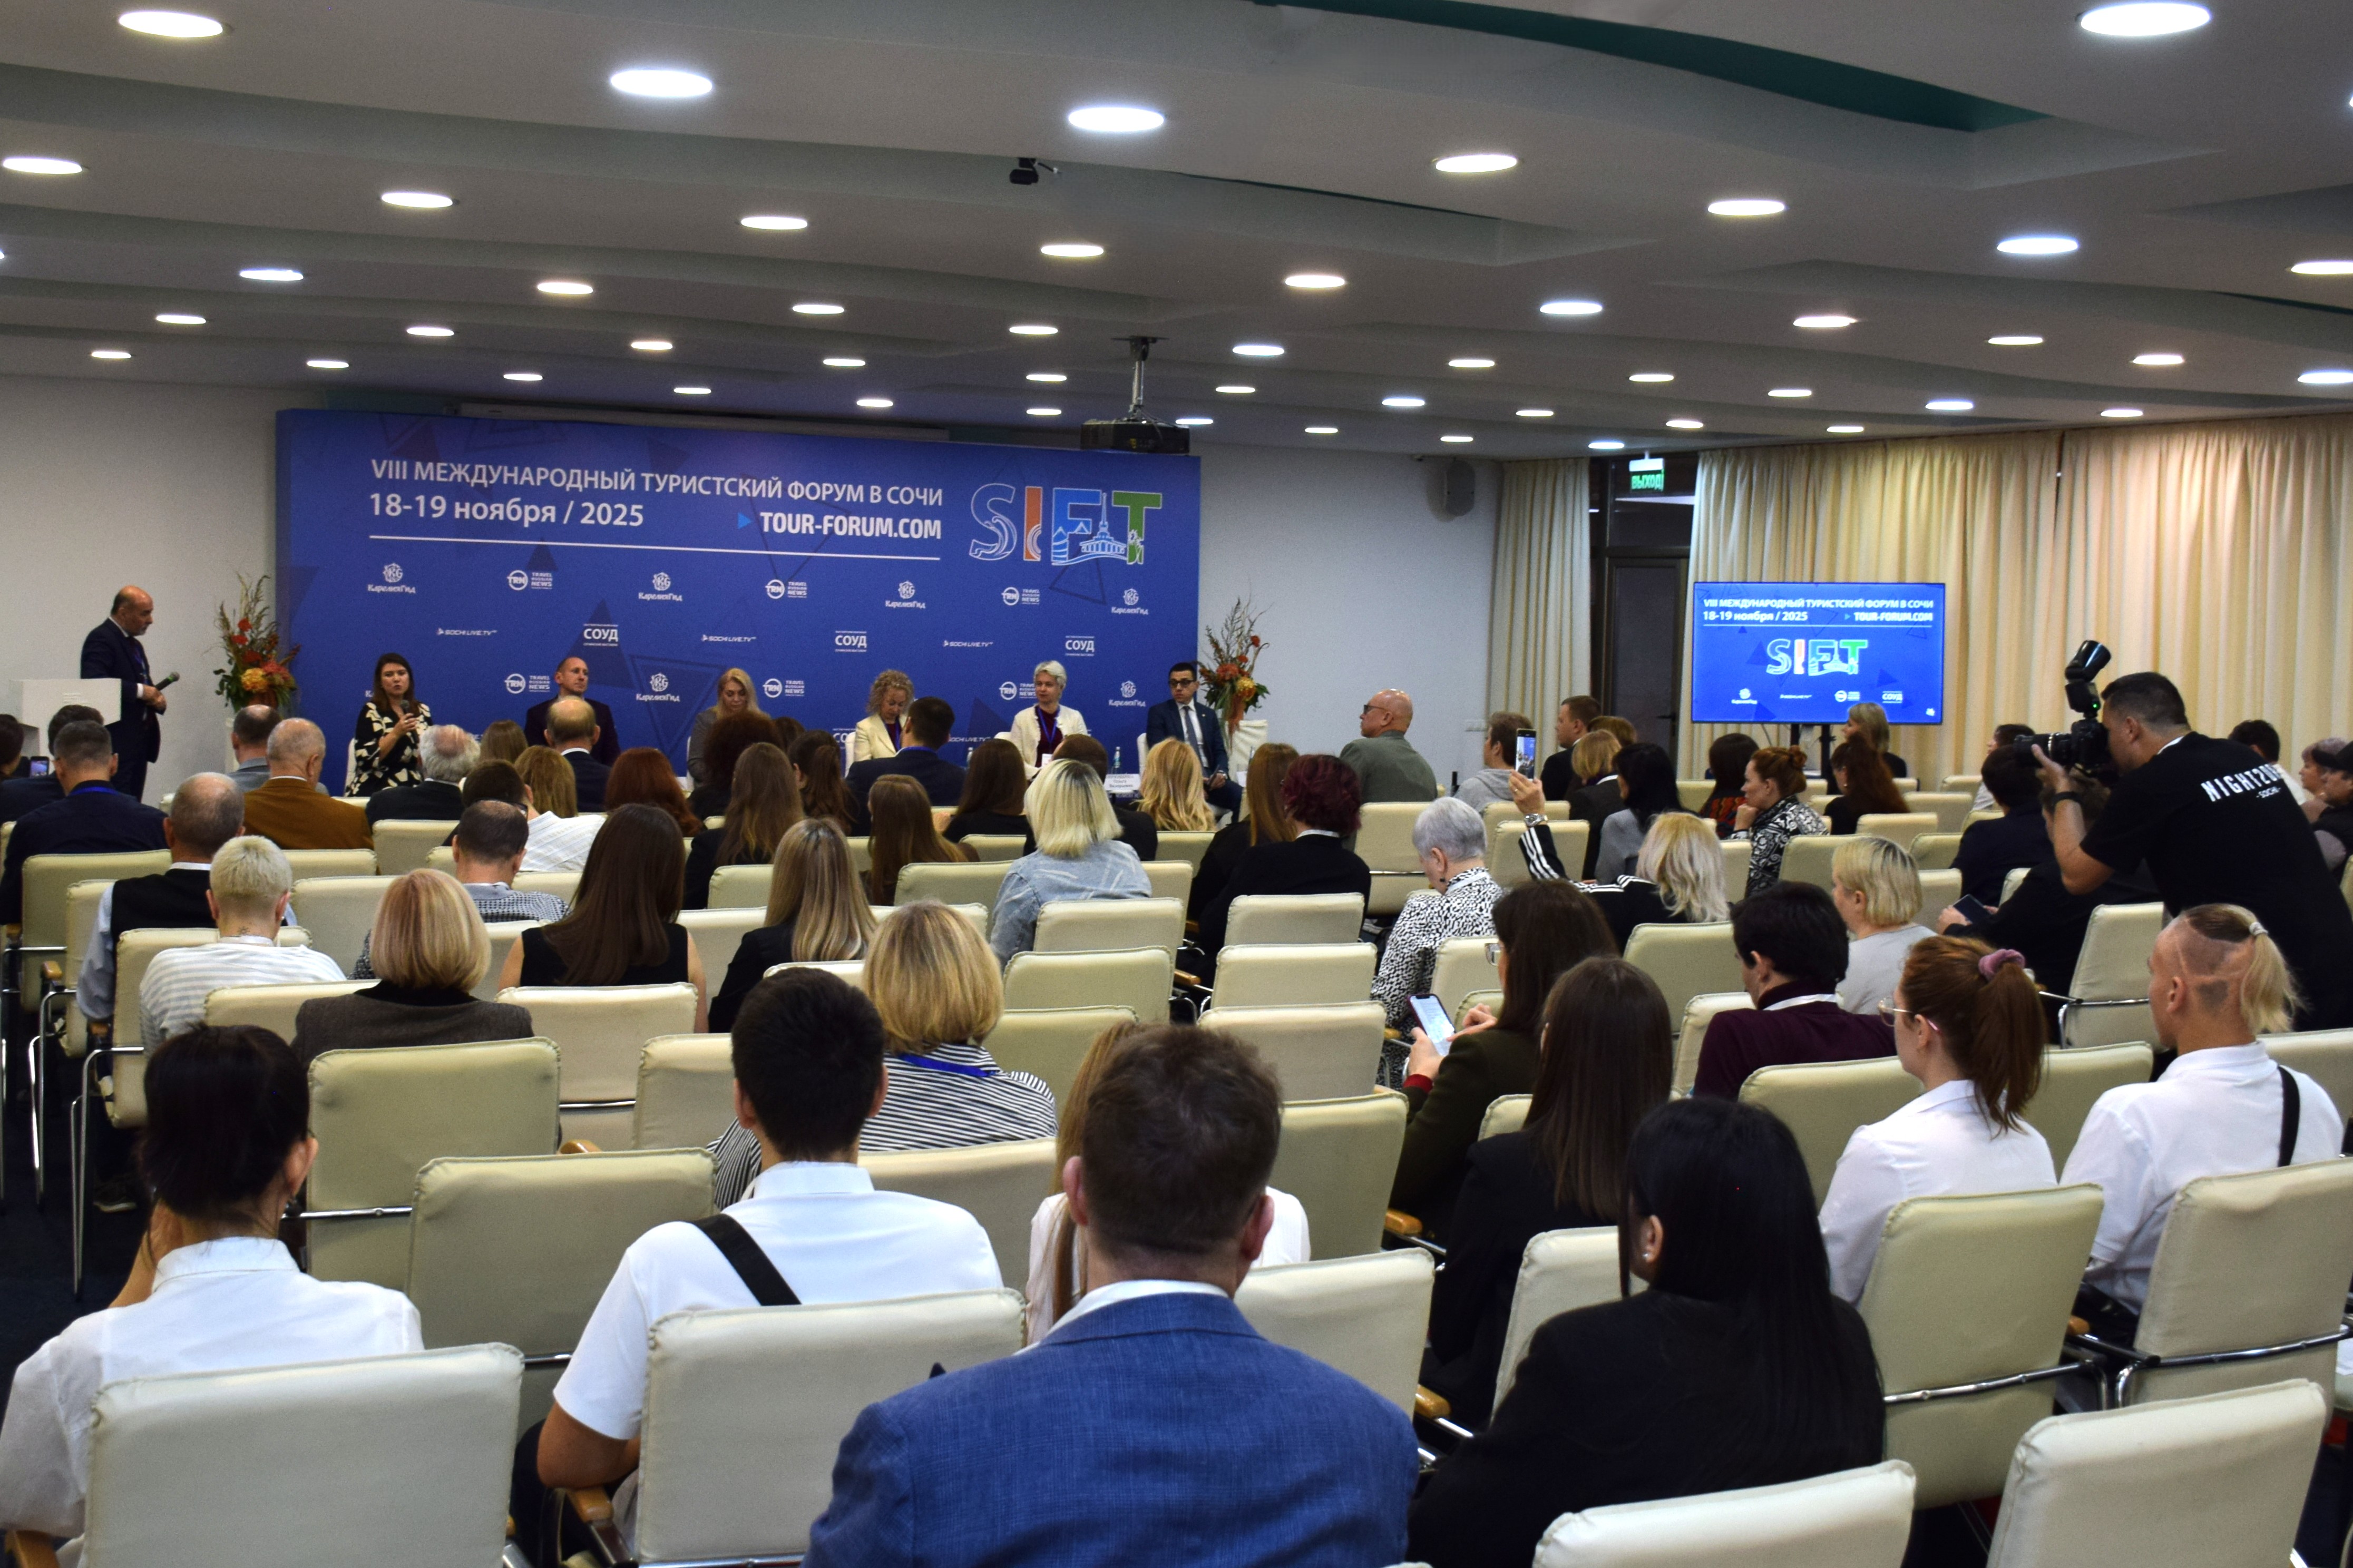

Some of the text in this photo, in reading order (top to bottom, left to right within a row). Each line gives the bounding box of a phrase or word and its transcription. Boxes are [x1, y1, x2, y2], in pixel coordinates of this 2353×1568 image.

[372, 459, 942, 506] VIII МЕЖДУНАРОДНЫЙ ТУРИСТСКИЙ ФОРУМ В СОЧИ
[1632, 474, 1663, 491] ВЫХОД
[370, 493, 643, 527] 18-19 ноября / 2025
[759, 512, 941, 540] TOUR-FORUM.COM
[969, 483, 1163, 565] SIFT
[1719, 599, 1805, 609] МЕЖДУНАРОДНЫЙ
[1806, 598, 1864, 608] ТУРИСТСКИЙ
[1865, 600, 1899, 608] ФОРУМ
[1908, 600, 1934, 608] СОЧИ
[1703, 610, 1808, 623] 18-19 ноября / 2025
[1853, 612, 1934, 621] TOUR-FORUM.COM
[583, 628, 619, 642] СОУД
[835, 635, 867, 649] СОУД
[1065, 640, 1095, 653] СОУД
[1766, 639, 1868, 677] SIFT
